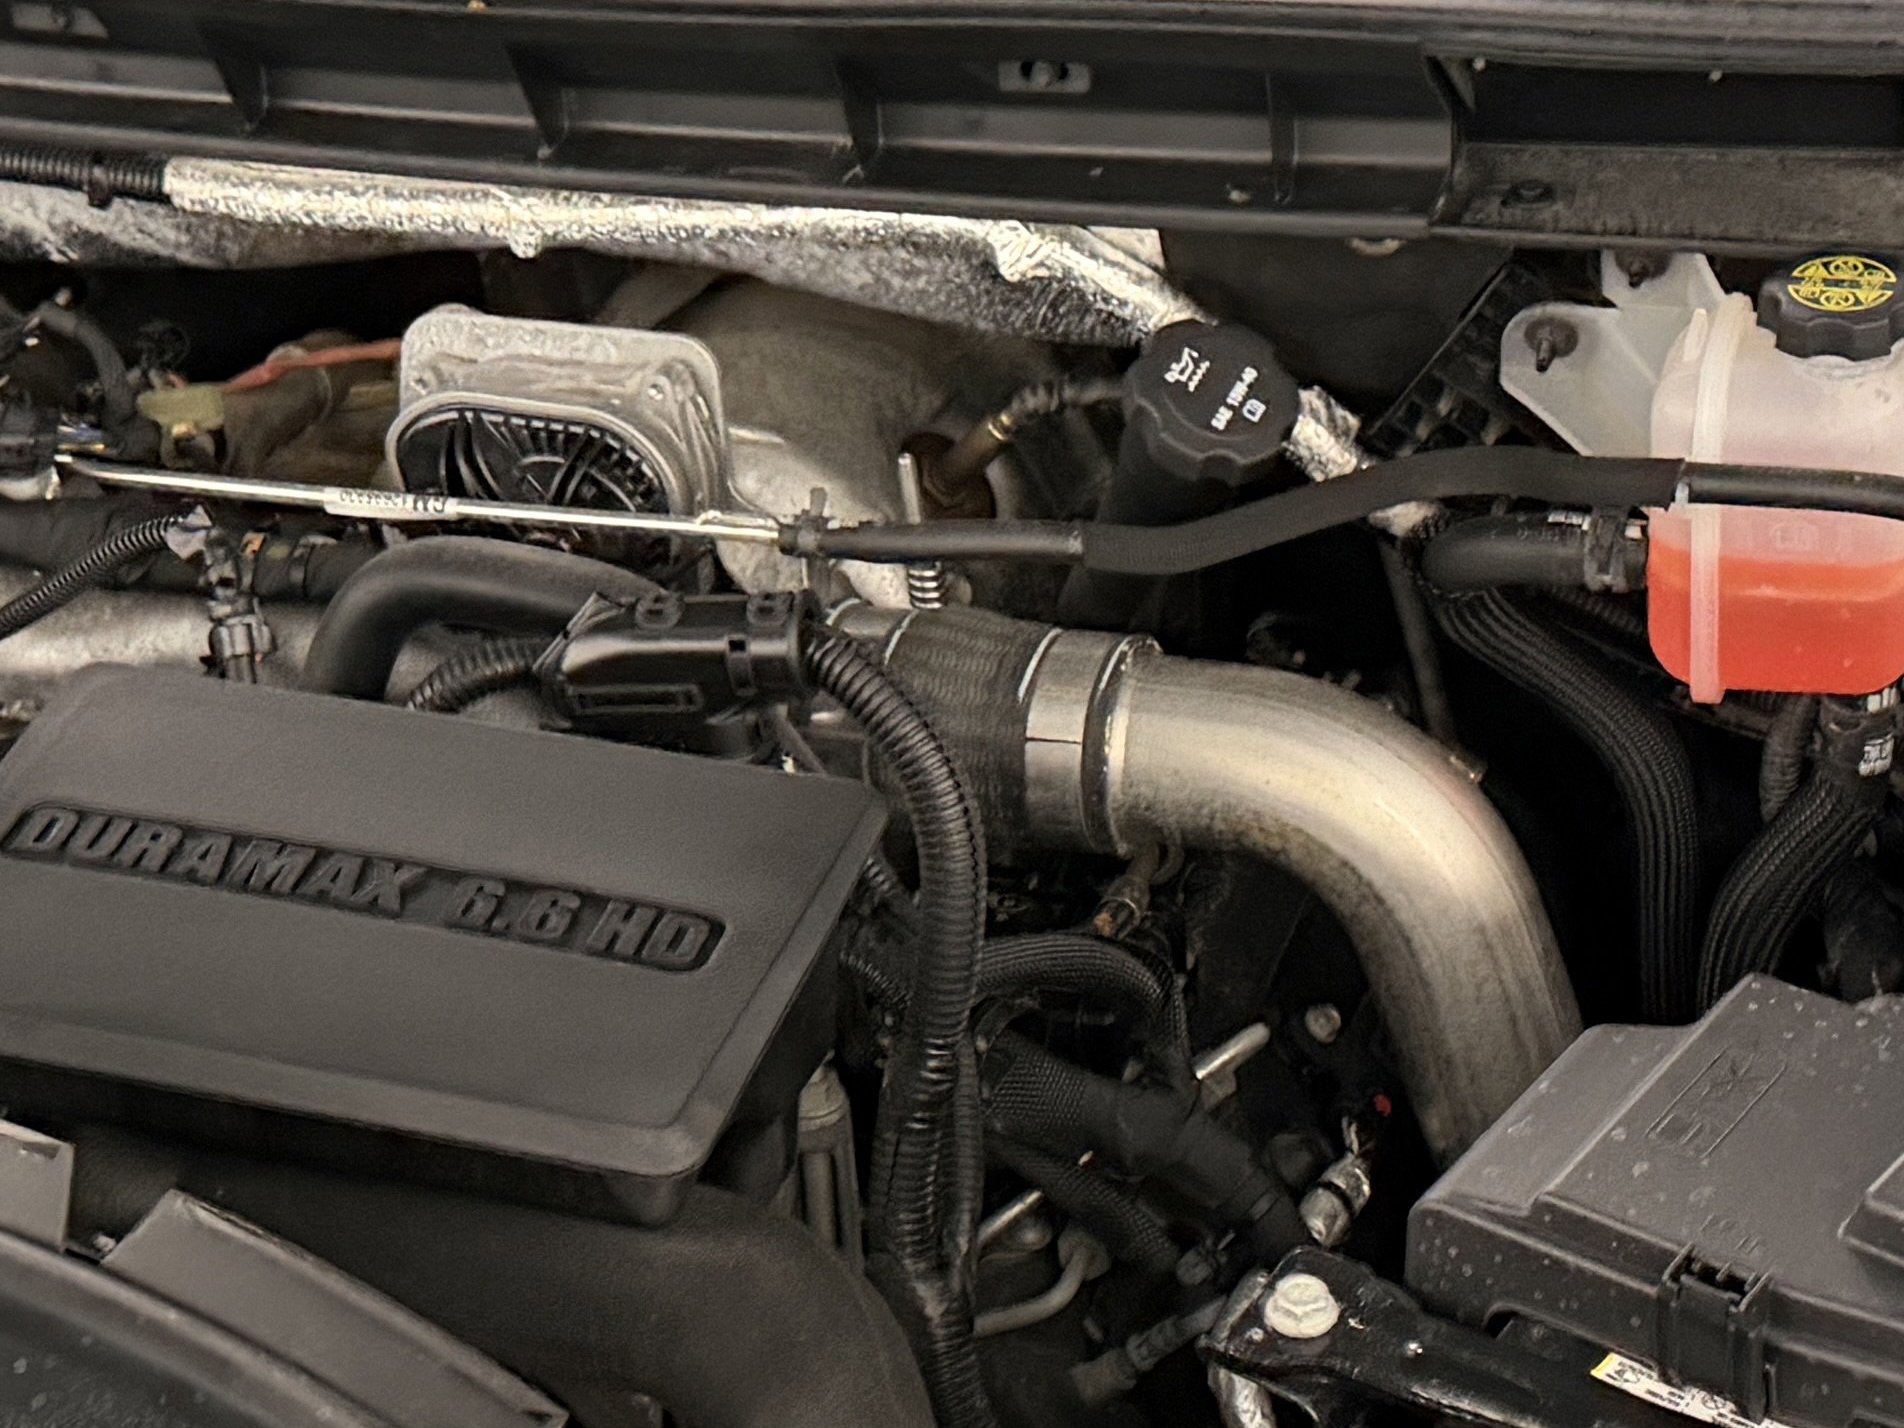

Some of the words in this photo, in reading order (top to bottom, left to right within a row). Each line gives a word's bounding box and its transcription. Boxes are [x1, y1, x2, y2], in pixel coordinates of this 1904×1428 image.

[20, 807, 426, 912] DURAMAX
[449, 878, 583, 941] 6.6
[586, 902, 712, 965] HD
